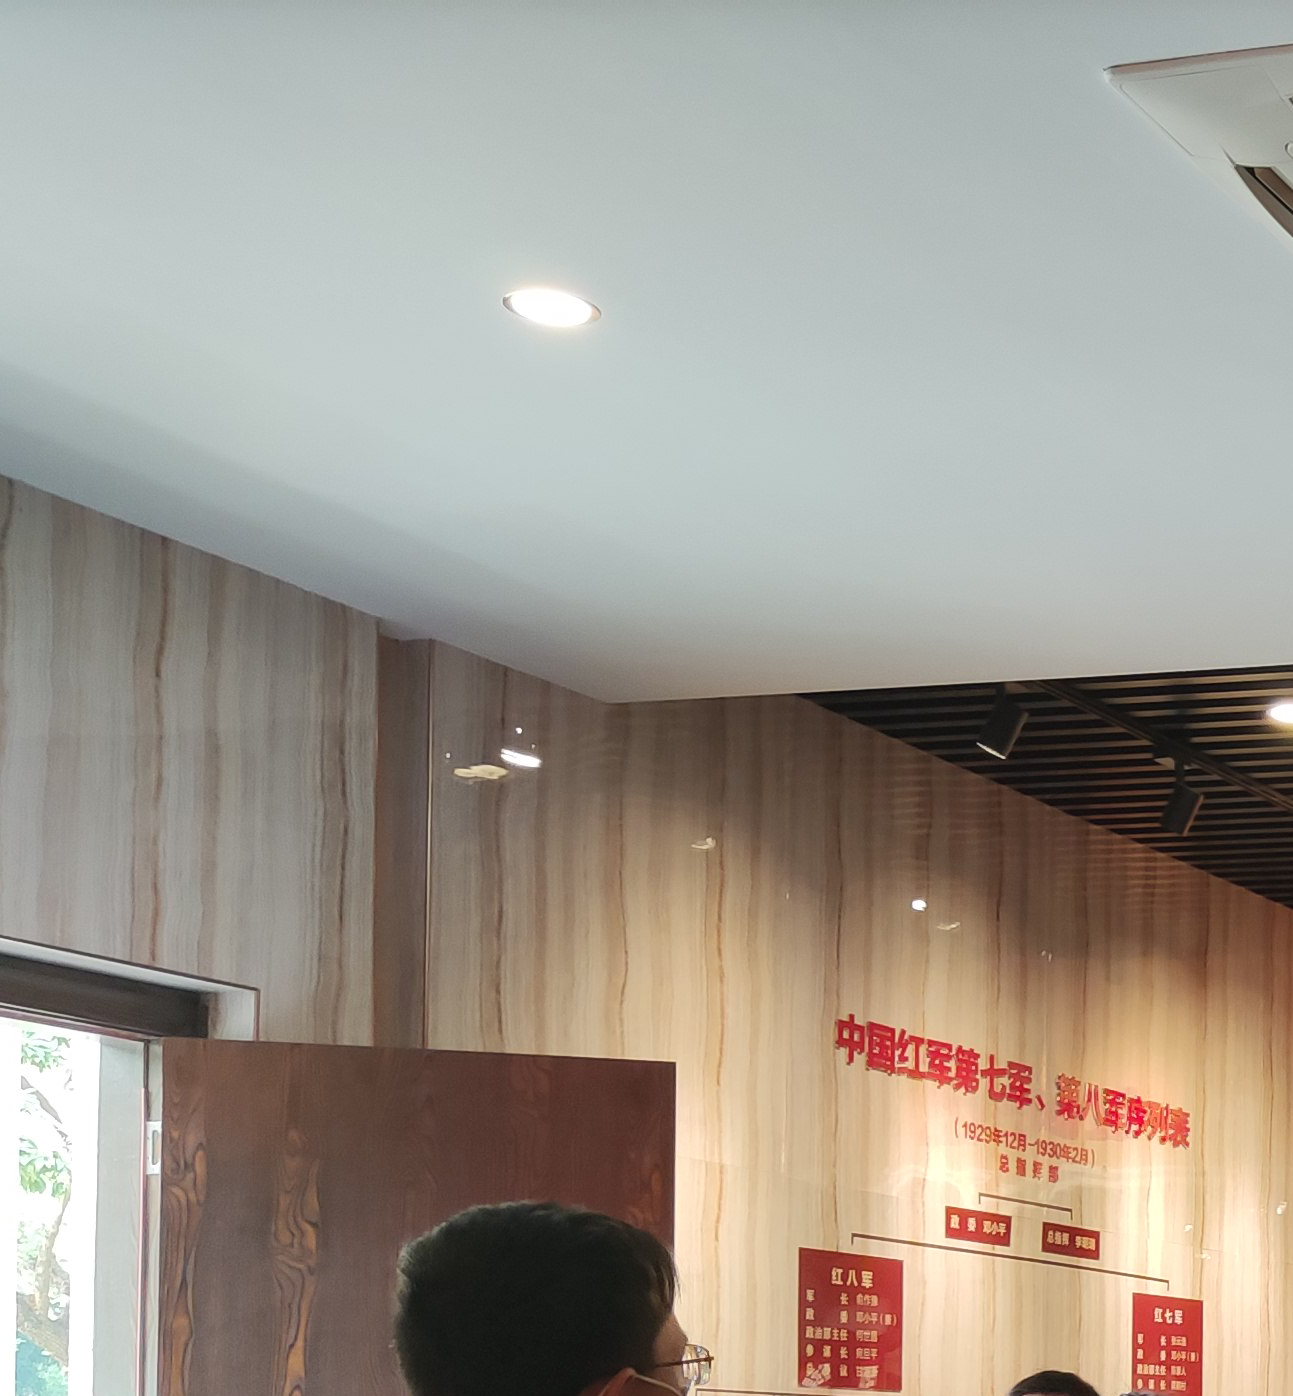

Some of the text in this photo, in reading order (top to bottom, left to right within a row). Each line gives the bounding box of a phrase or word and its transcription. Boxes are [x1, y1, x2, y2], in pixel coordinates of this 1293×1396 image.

[834, 1013, 1191, 1149] 中国红军第七军、第八军序列表
[831, 1267, 873, 1288] 红八军
[1154, 1307, 1183, 1325] 红七军
